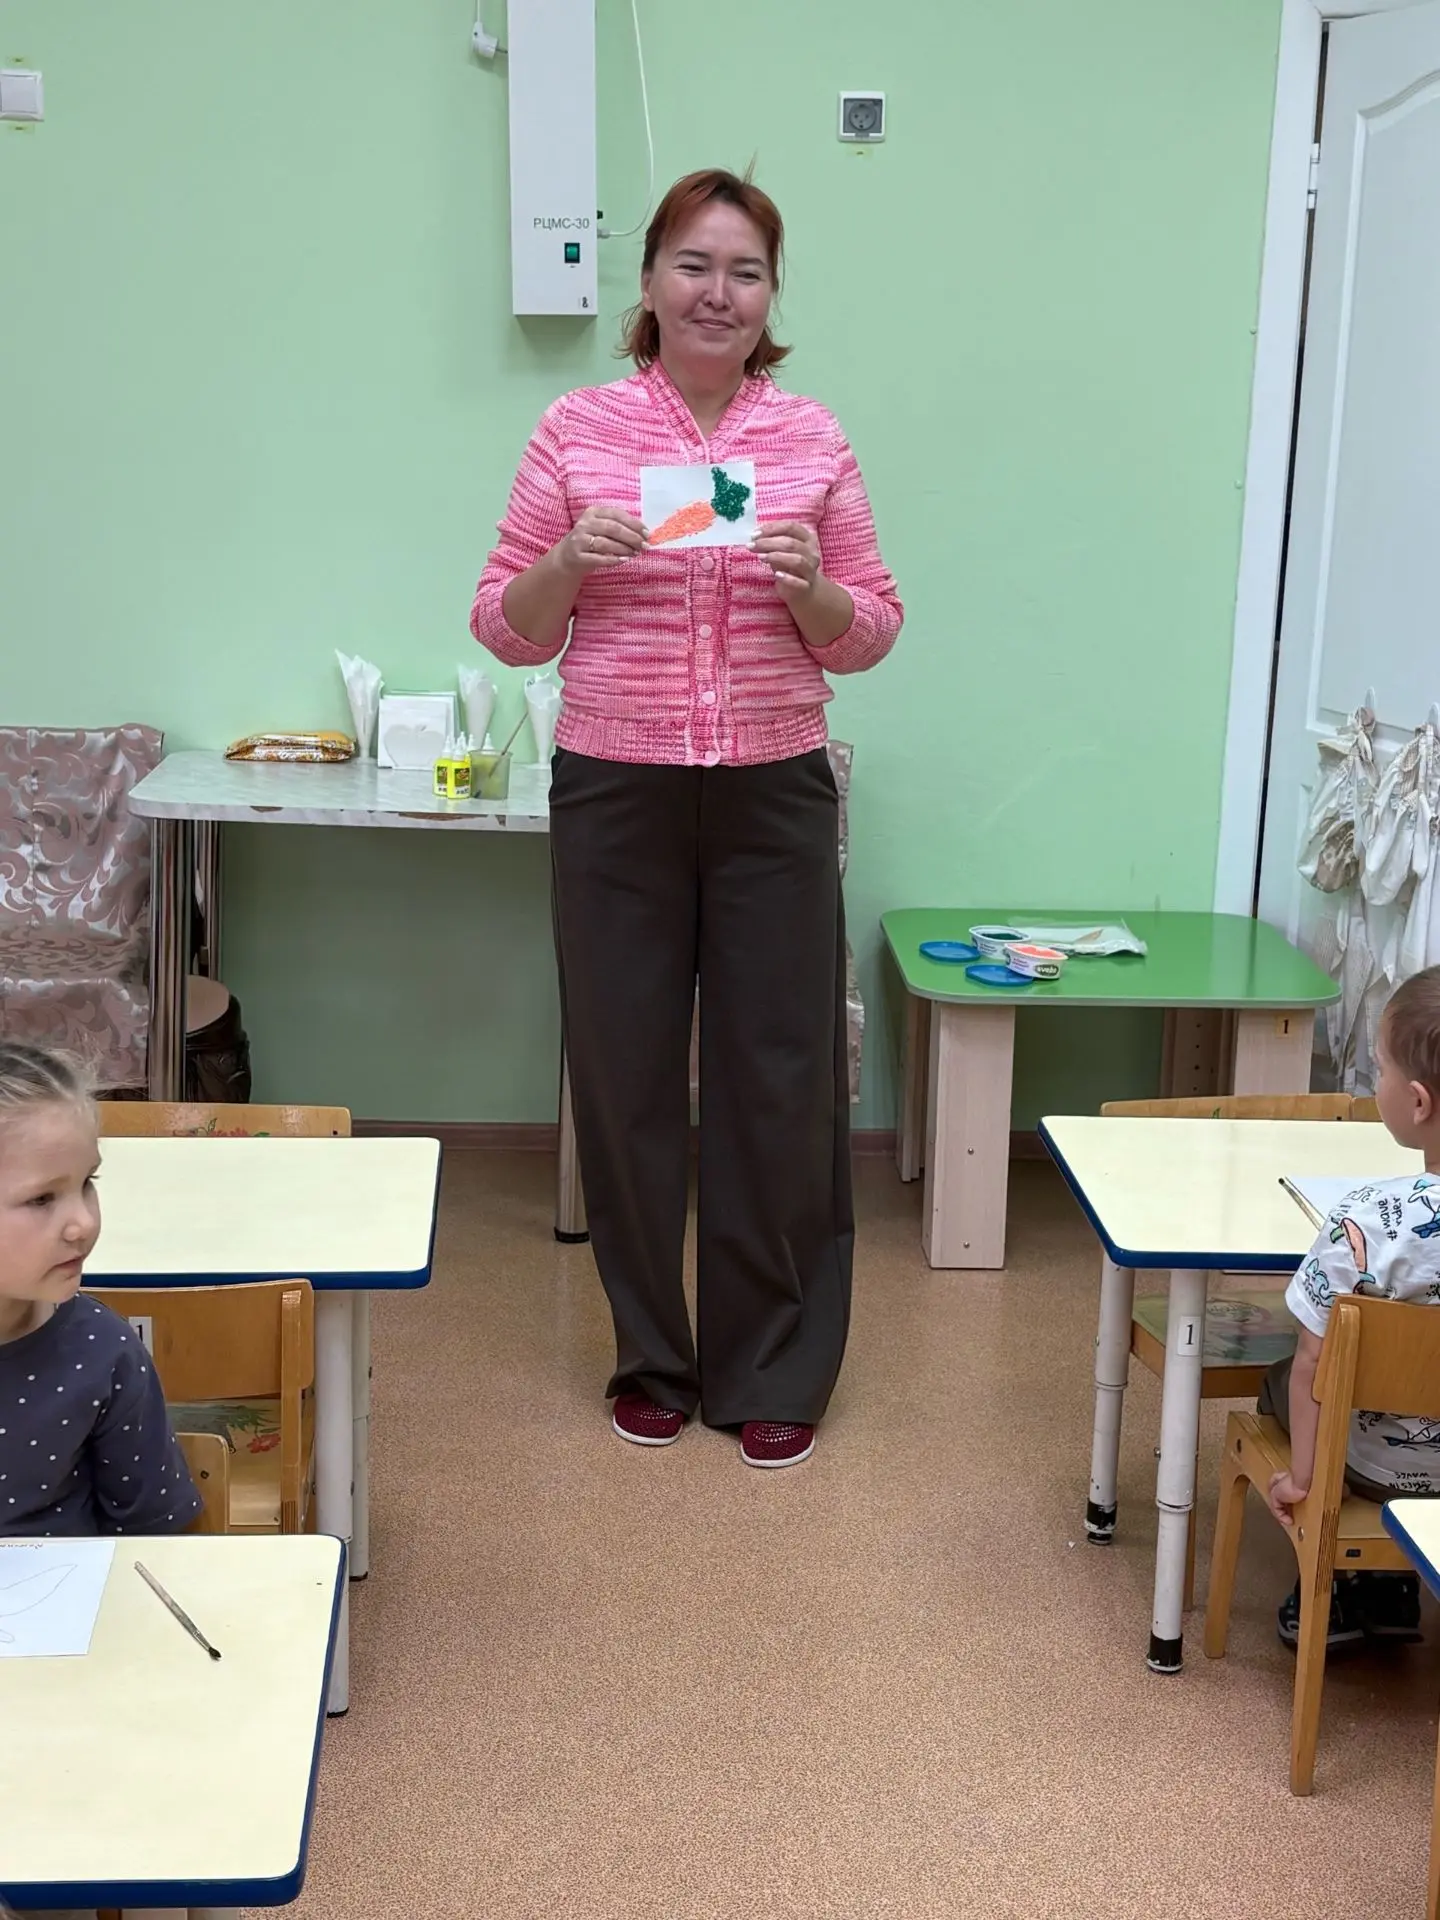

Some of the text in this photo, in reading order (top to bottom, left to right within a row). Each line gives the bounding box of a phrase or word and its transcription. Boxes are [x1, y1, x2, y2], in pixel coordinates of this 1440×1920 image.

[533, 217, 590, 231] РЦМС-30
[1283, 1018, 1290, 1035] 1
[1185, 1323, 1194, 1346] 1
